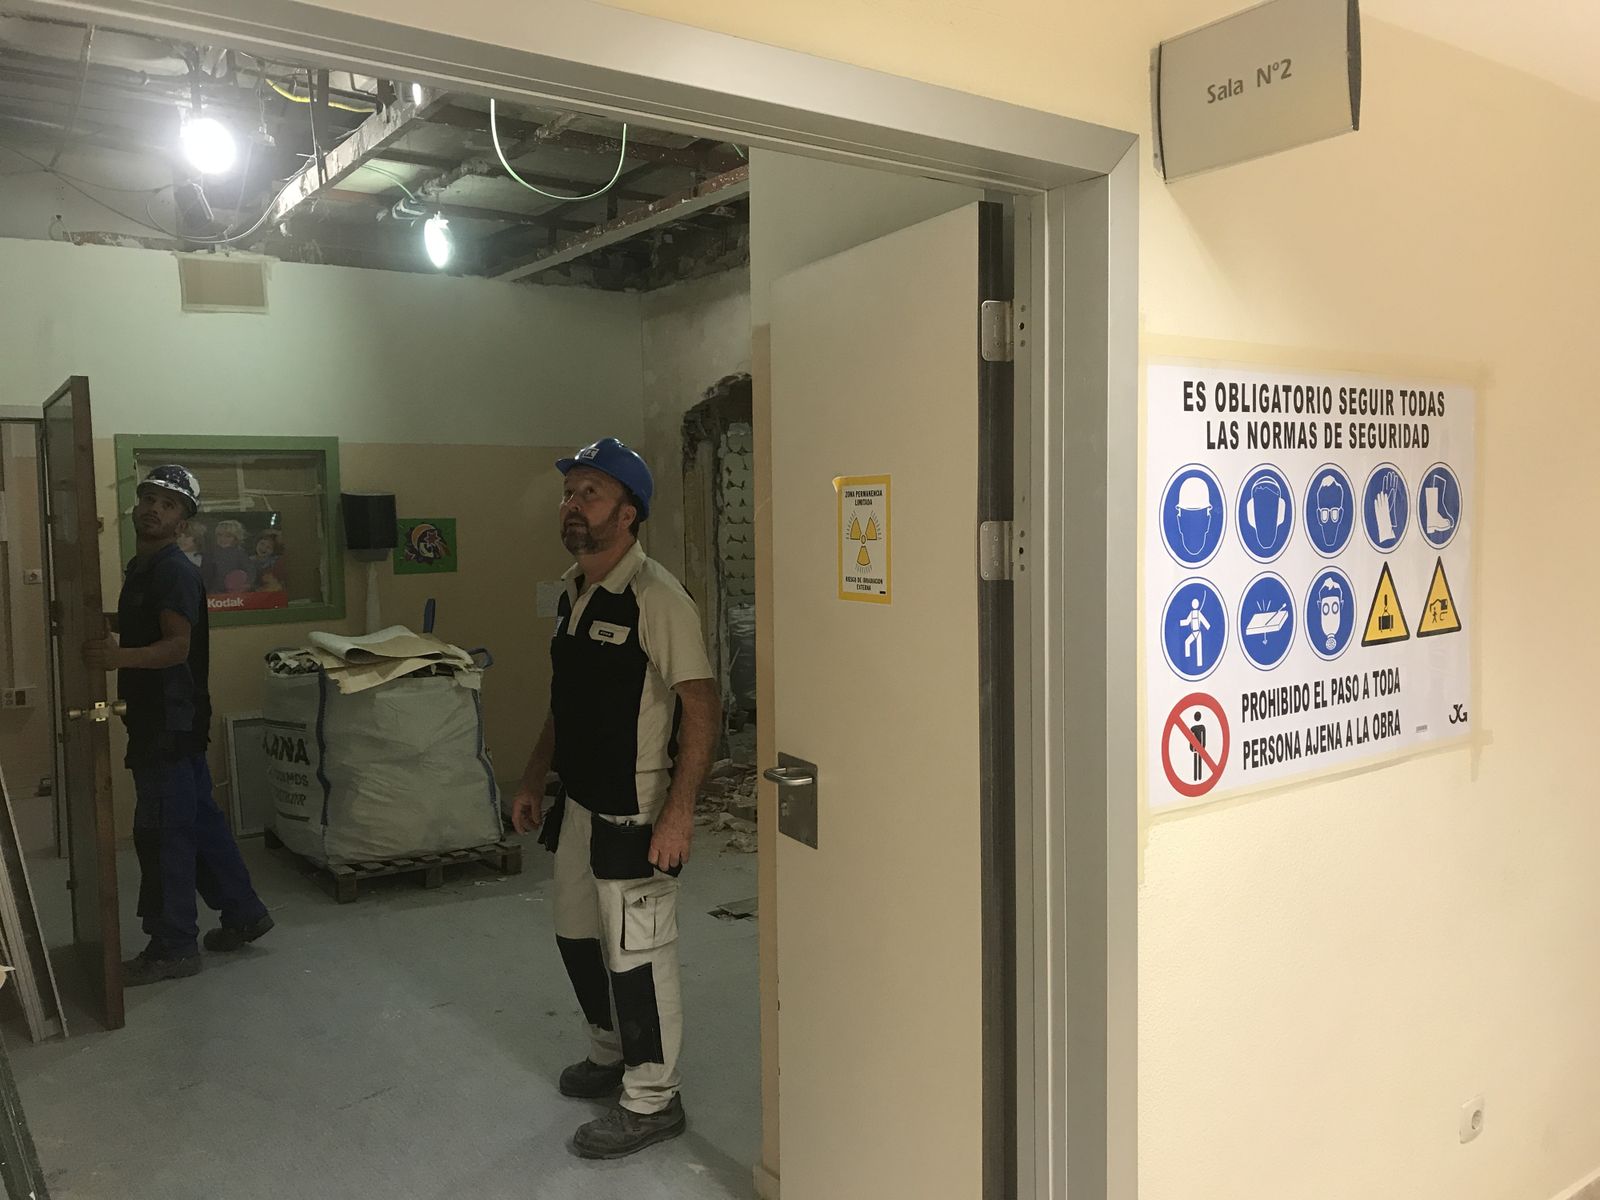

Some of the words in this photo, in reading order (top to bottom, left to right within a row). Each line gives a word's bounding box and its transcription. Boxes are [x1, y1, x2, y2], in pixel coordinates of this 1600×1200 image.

[1207, 78, 1244, 104] Sala
[1184, 381, 1206, 412] ES
[1215, 382, 1332, 414] OBLIGATORIO
[1339, 387, 1394, 415] SEGUIR
[1400, 390, 1444, 417] TODAS
[1207, 421, 1239, 449] LAS
[1248, 421, 1317, 449] NORMAS
[1325, 423, 1342, 448] DE
[1349, 423, 1429, 449] SEGURIDAD
[856, 490, 883, 498] PERMANENCIA
[207, 597, 245, 609] Kodak
[1242, 683, 1310, 723] PROHIBIDO
[1314, 681, 1327, 709] EL
[1331, 675, 1359, 705] PASO
[1363, 673, 1369, 699] A
[1373, 667, 1400, 697] TODA
[1243, 731, 1301, 770] PERSONA
[1305, 722, 1342, 756] AJENA
[1346, 720, 1353, 747] A
[1357, 716, 1369, 744] LA
[1373, 709, 1401, 739] OBRA
